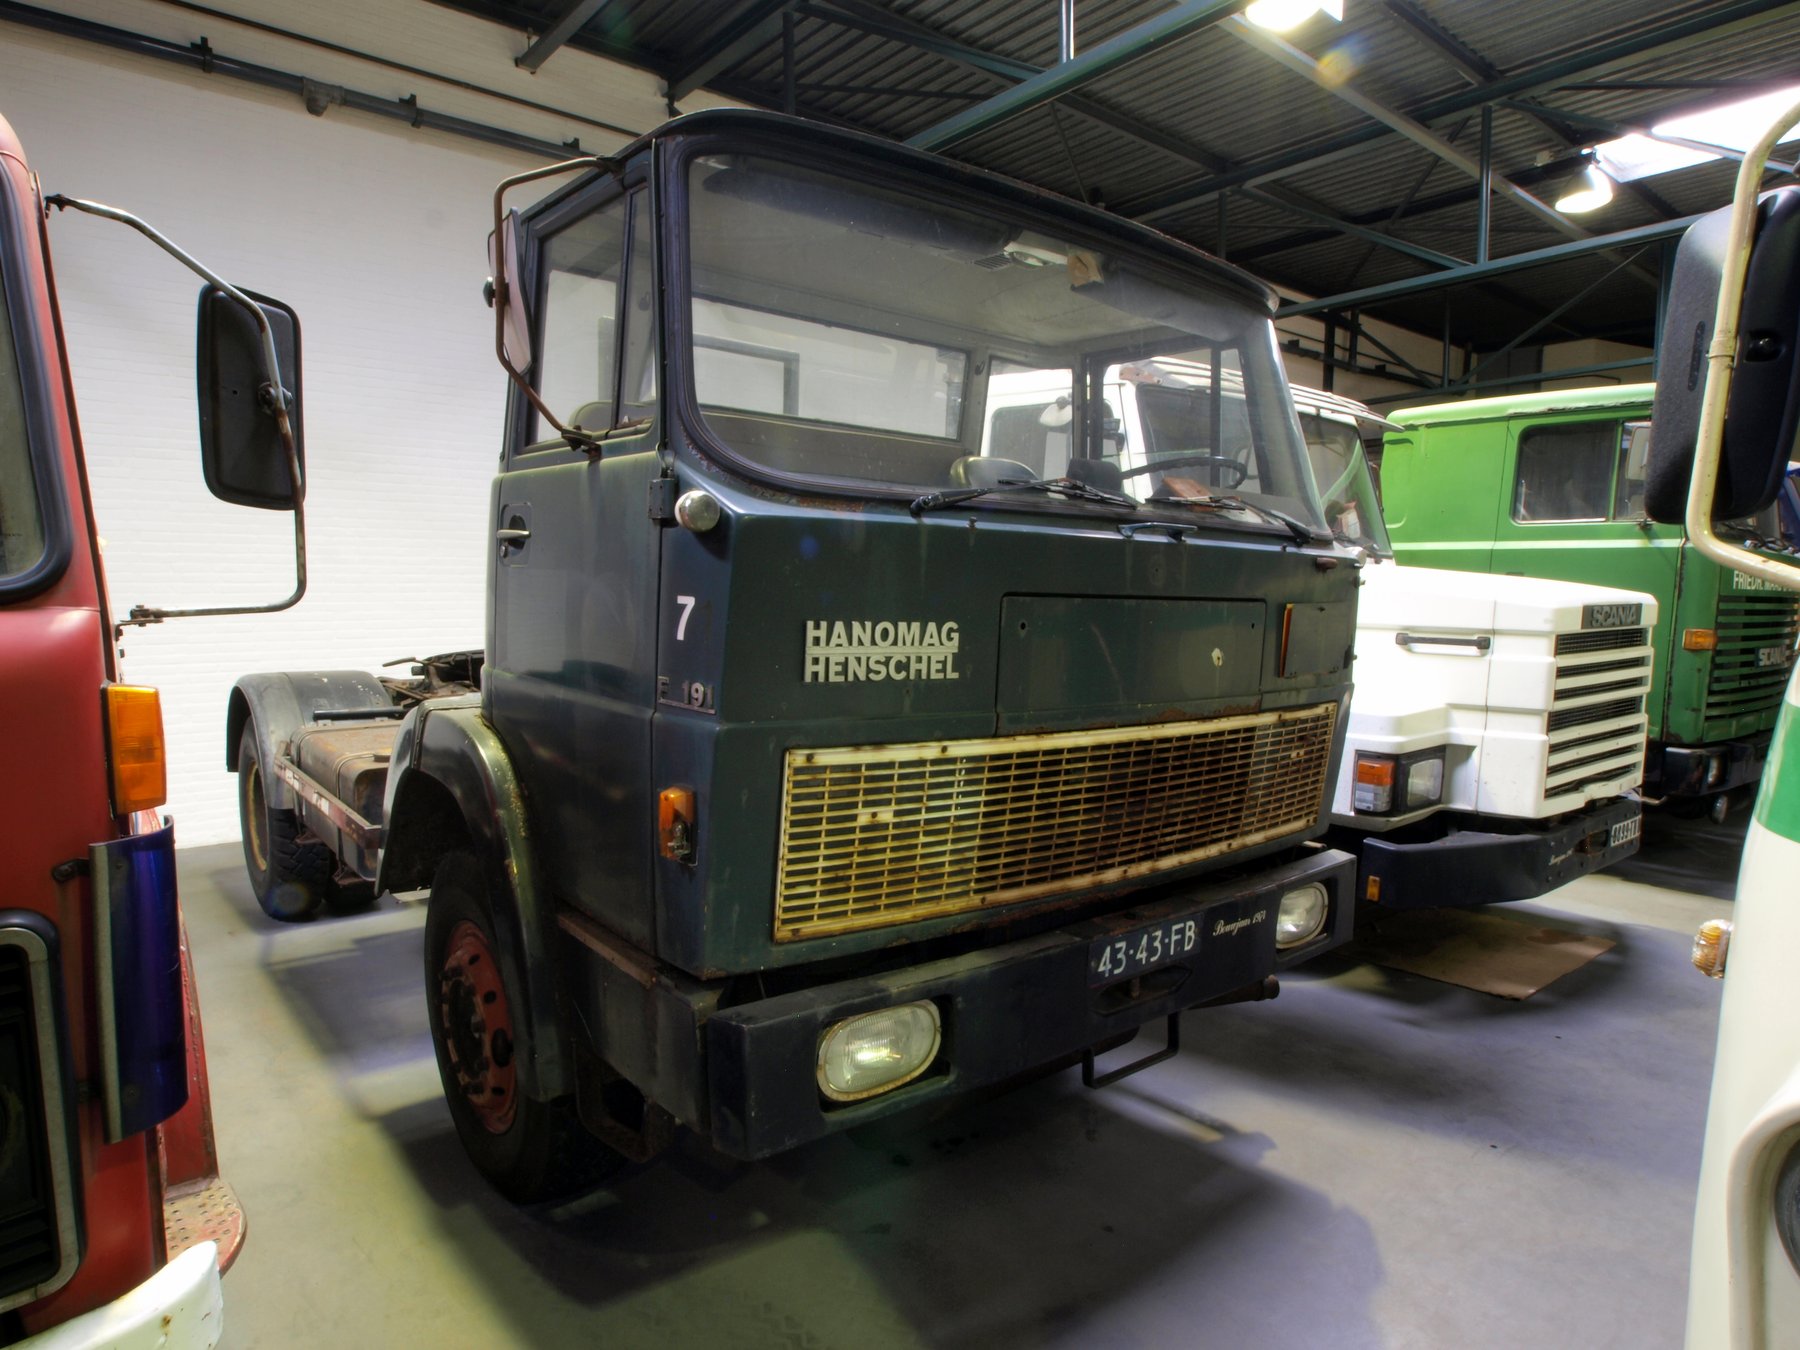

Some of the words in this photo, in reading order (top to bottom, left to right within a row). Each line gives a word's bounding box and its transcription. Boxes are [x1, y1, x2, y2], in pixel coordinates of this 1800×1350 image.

[676, 595, 696, 641] 7
[1592, 605, 1637, 627] SCANIA
[805, 620, 960, 648] HANOMAG
[804, 653, 960, 683] HENSCHEL
[682, 681, 714, 708] 191
